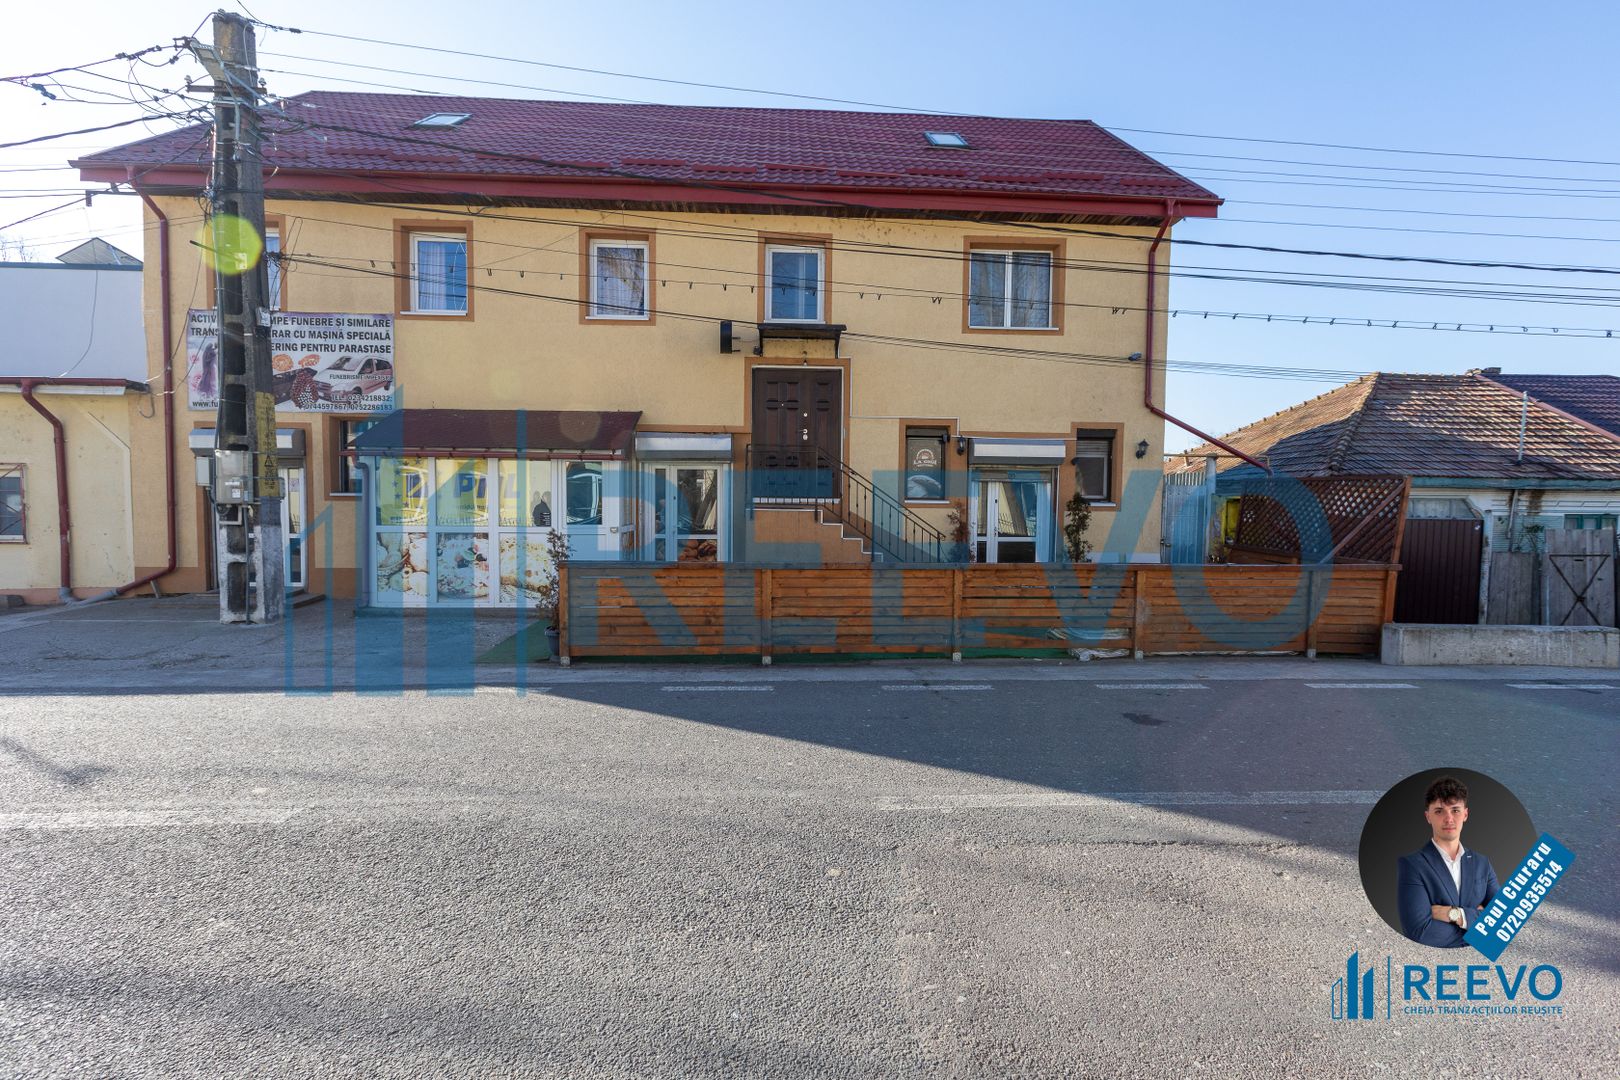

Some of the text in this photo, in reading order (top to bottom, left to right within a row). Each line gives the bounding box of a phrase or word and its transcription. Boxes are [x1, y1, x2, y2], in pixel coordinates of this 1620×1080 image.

[191, 314, 217, 323] ACTIV
[270, 317, 289, 325] MPE
[291, 317, 333, 327] FUNEBRE
[347, 318, 391, 328] SIMILARE
[191, 327, 219, 337] TRANS
[293, 330, 306, 339] CU
[271, 342, 391, 353] ERING PENTRU PARASTASE
[192, 400, 219, 408] www.fu
